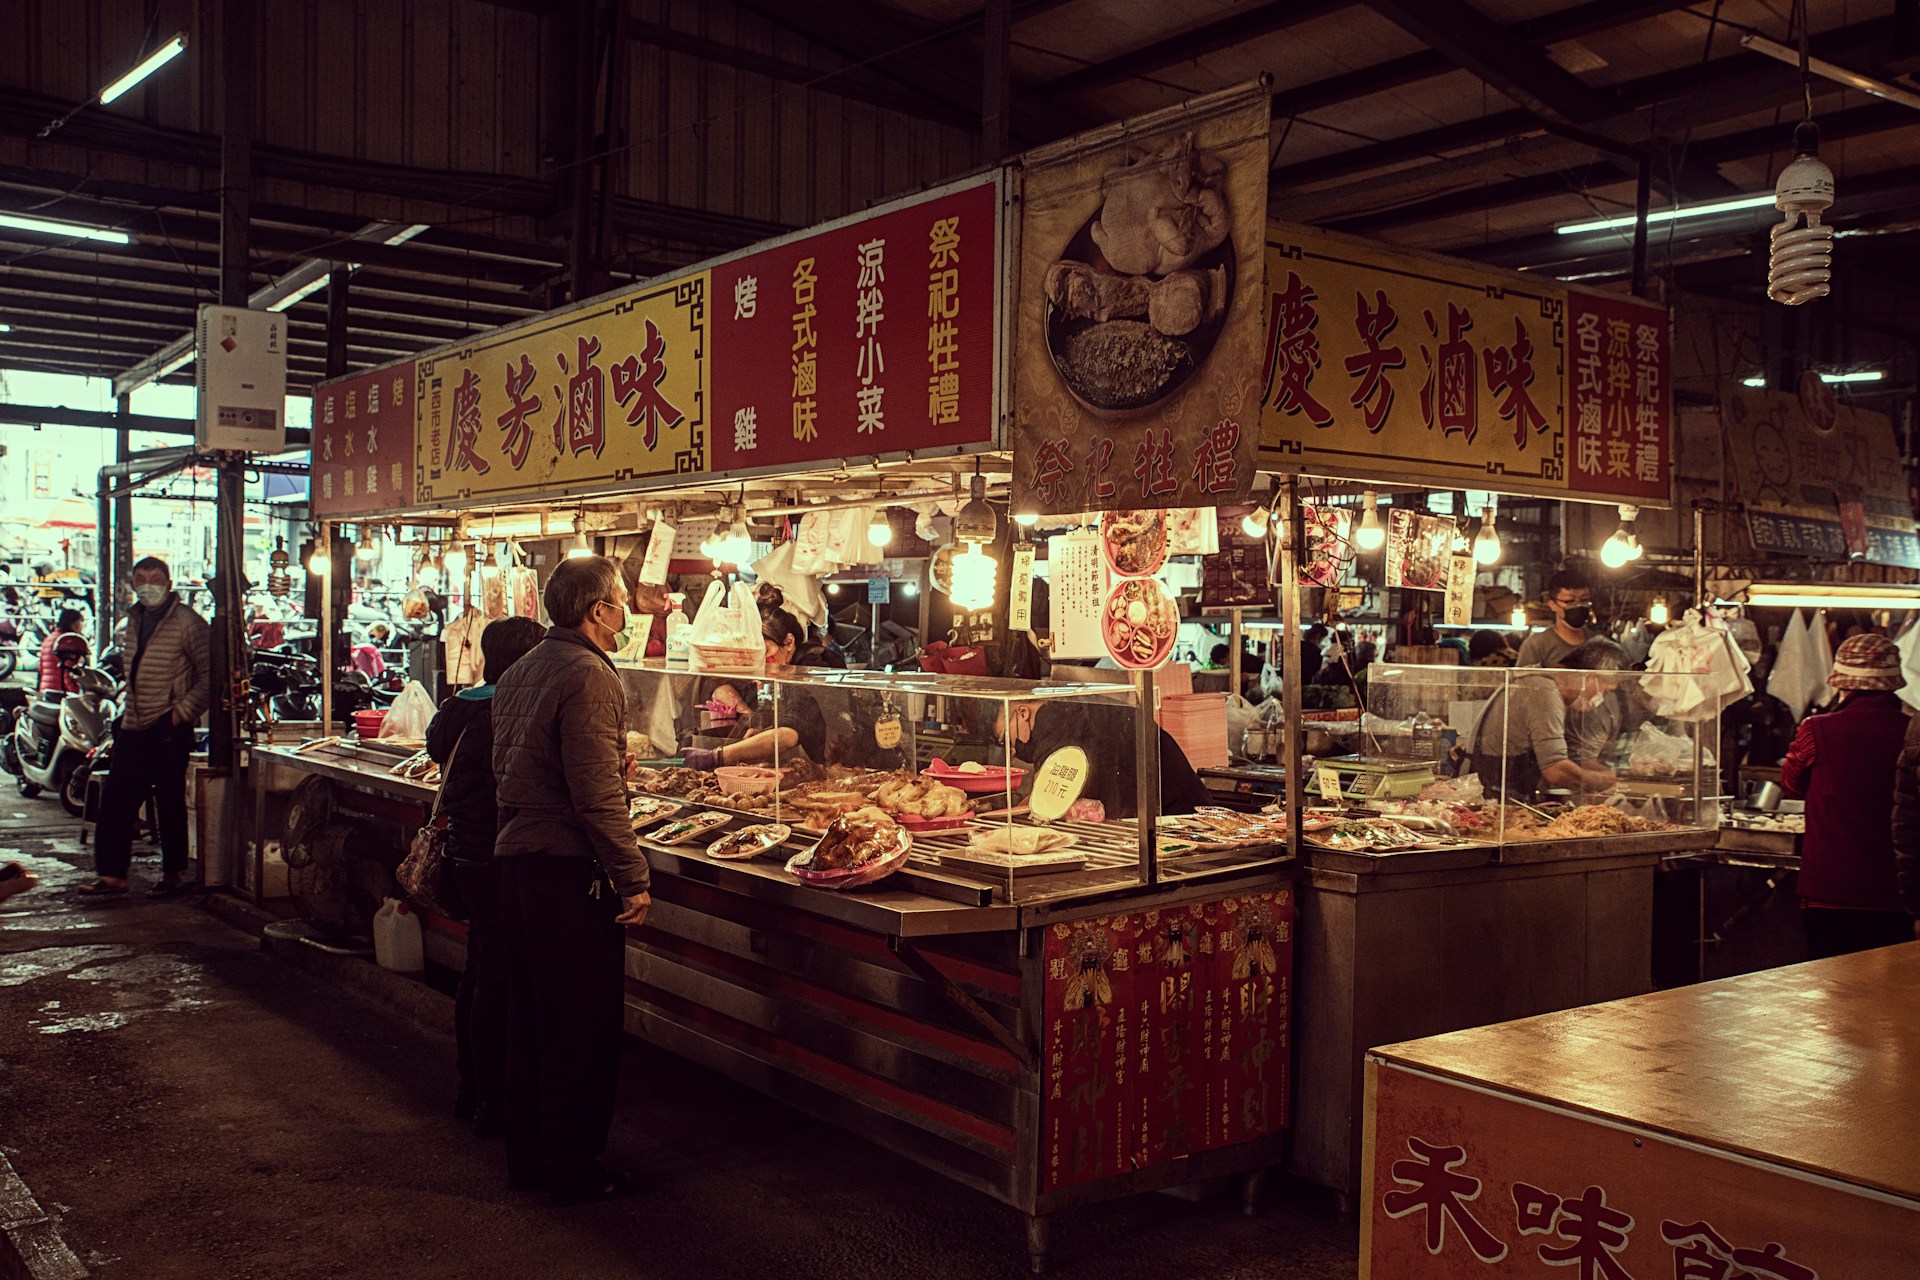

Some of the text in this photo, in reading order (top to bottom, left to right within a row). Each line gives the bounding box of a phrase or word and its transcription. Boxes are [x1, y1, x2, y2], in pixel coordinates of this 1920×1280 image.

[444, 317, 685, 475] 慶芳滷味
[734, 274, 758, 452] 烤雞
[792, 257, 818, 442] 各式滷味
[856, 238, 885, 434] 涼拌小菜
[927, 216, 960, 426] 祭祀牲禮
[1261, 270, 1550, 451] 慶芳滷味
[1576, 312, 1602, 476] 各式滷味
[1606, 318, 1632, 479] 涼拌小菜
[1635, 323, 1661, 483] 祭祀牲禮
[1030, 418, 1240, 503] 祭祀牲禮
